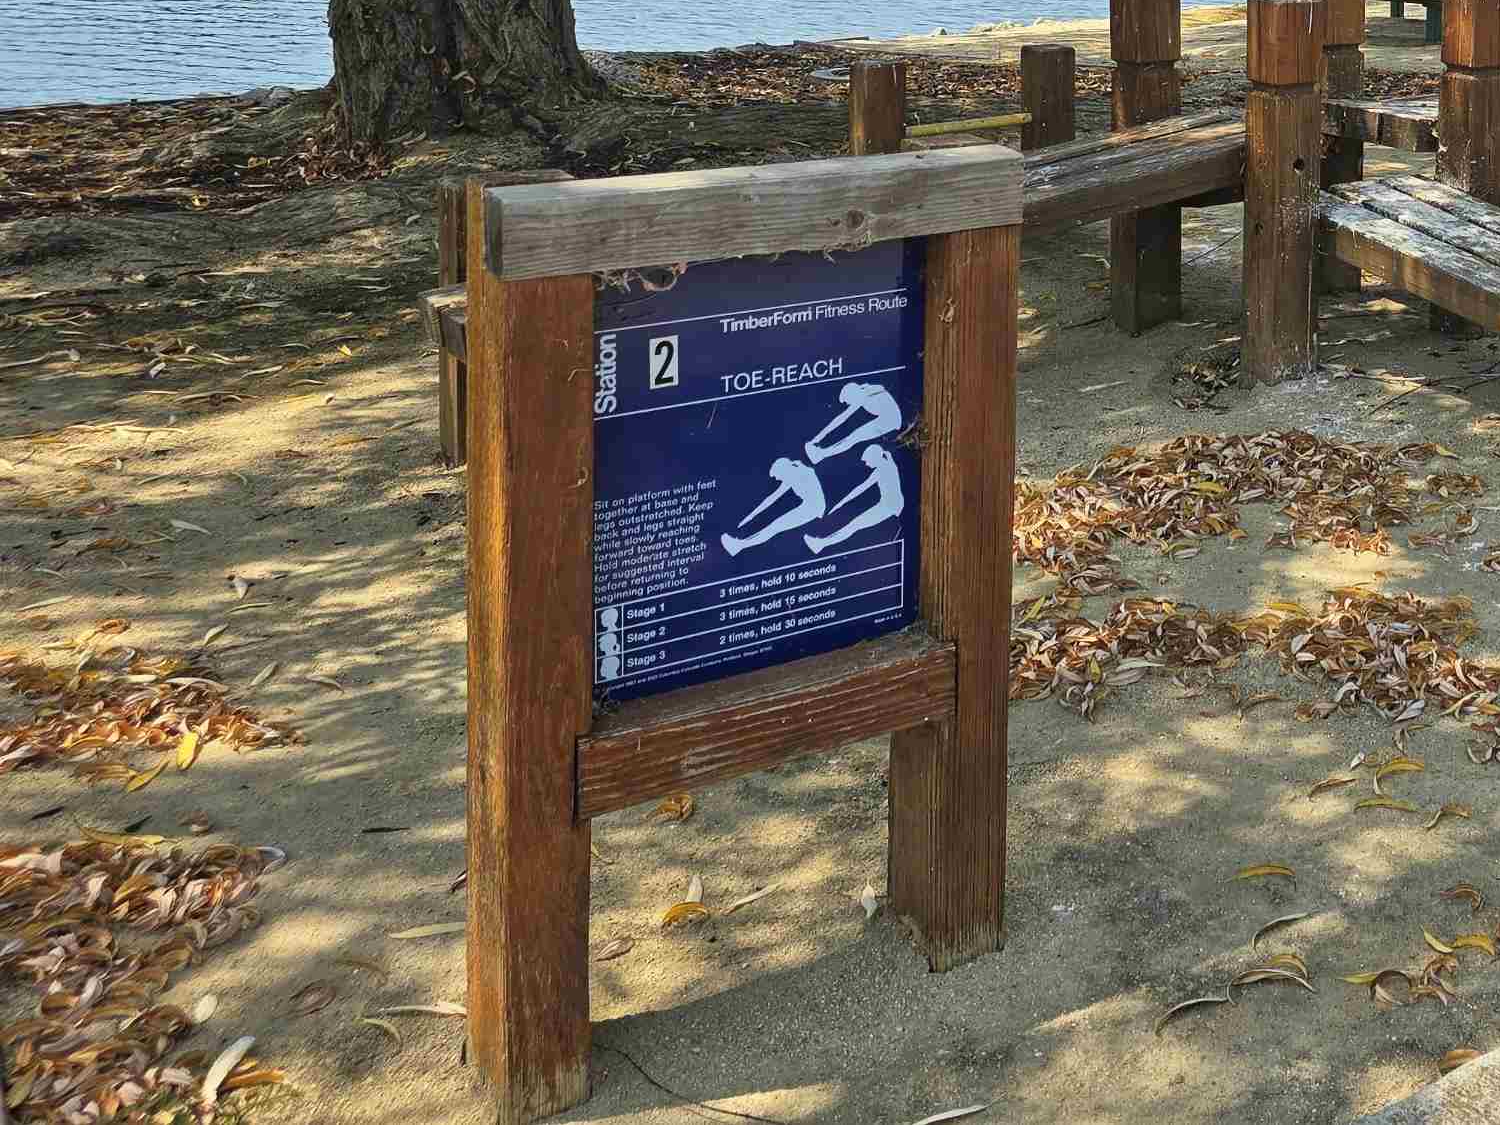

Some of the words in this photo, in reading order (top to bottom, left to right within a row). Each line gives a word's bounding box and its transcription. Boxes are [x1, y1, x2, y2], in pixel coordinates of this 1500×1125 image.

[720, 310, 812, 333] TimberForm
[815, 303, 865, 320] Fitness
[868, 295, 908, 312] Route
[594, 334, 616, 414] Station
[654, 340, 675, 385] 2
[721, 357, 843, 393] TOE-REACH
[594, 501, 608, 510] Sit
[612, 498, 624, 507] on
[628, 490, 670, 504] platform
[673, 483, 694, 494] with
[697, 480, 716, 489] feet
[594, 506, 638, 521] together
[641, 503, 650, 511] at
[655, 499, 678, 508] base
[682, 493, 698, 504] and
[594, 522, 615, 532] legs
[619, 507, 685, 526] outstretched.
[688, 501, 713, 512] Keep
[594, 530, 618, 541] back
[622, 525, 640, 535] and
[644, 521, 664, 532] legs
[667, 512, 704, 528] straight
[594, 540, 620, 551] while
[624, 534, 655, 547] slowly
[658, 524, 700, 538] reaching
[595, 547, 633, 561] forward
[638, 540, 671, 553] toward
[595, 560, 618, 572] Hold
[622, 551, 669, 566] moderate
[672, 542, 706, 556] stretch
[595, 573, 608, 582] for
[612, 562, 664, 578] suggested
[667, 552, 704, 567] interval
[595, 580, 627, 593] before
[631, 570, 675, 585] returning
[679, 567, 688, 575] to
[595, 587, 643, 604] beginning
[647, 578, 688, 593] position.
[720, 588, 726, 598] 3
[729, 581, 758, 597] times,
[761, 575, 782, 588] hold
[785, 573, 795, 582] 10
[798, 563, 836, 580] seconds
[627, 606, 656, 620] Stage
[660, 603, 665, 613] 1
[720, 611, 726, 621] 3
[729, 604, 758, 620] times,
[761, 600, 782, 613] hold
[798, 586, 836, 603] seconds
[627, 630, 656, 643] Stage
[659, 626, 666, 636] 2
[720, 635, 726, 645] 2
[729, 627, 758, 644] times,
[761, 622, 782, 634] hold
[785, 618, 795, 629] 30
[798, 609, 836, 626] seconds
[627, 654, 656, 668] Stage
[659, 650, 666, 660] 3
